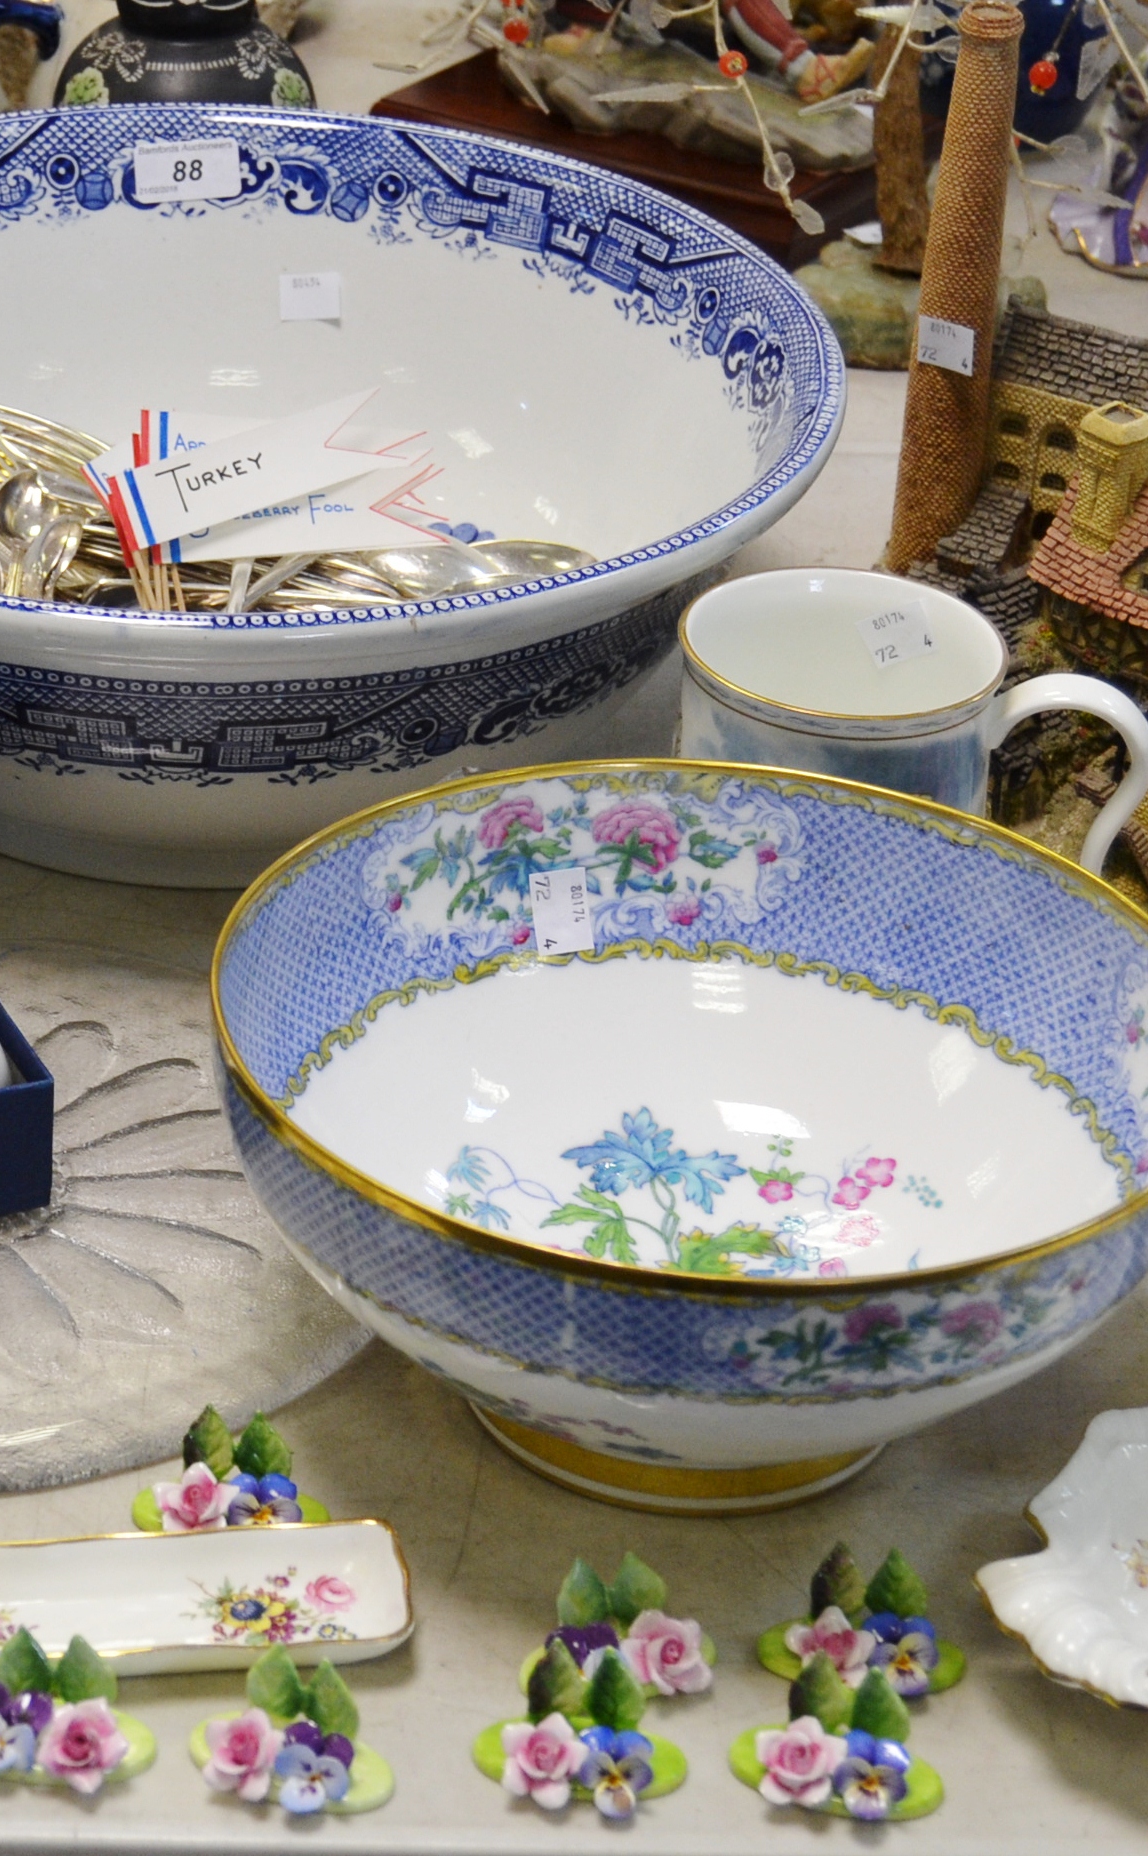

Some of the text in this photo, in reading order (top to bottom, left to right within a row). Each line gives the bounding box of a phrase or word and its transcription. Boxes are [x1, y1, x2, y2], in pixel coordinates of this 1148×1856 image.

[173, 159, 203, 182] 88
[921, 345, 969, 370] 72 4
[155, 452, 263, 513] TURKEY
[308, 494, 355, 525] FOOL
[872, 611, 905, 631] 80174
[875, 634, 933, 663] 72 4
[535, 876, 551, 902] 72
[570, 885, 586, 923] 80174
[544, 938, 558, 950] 4
